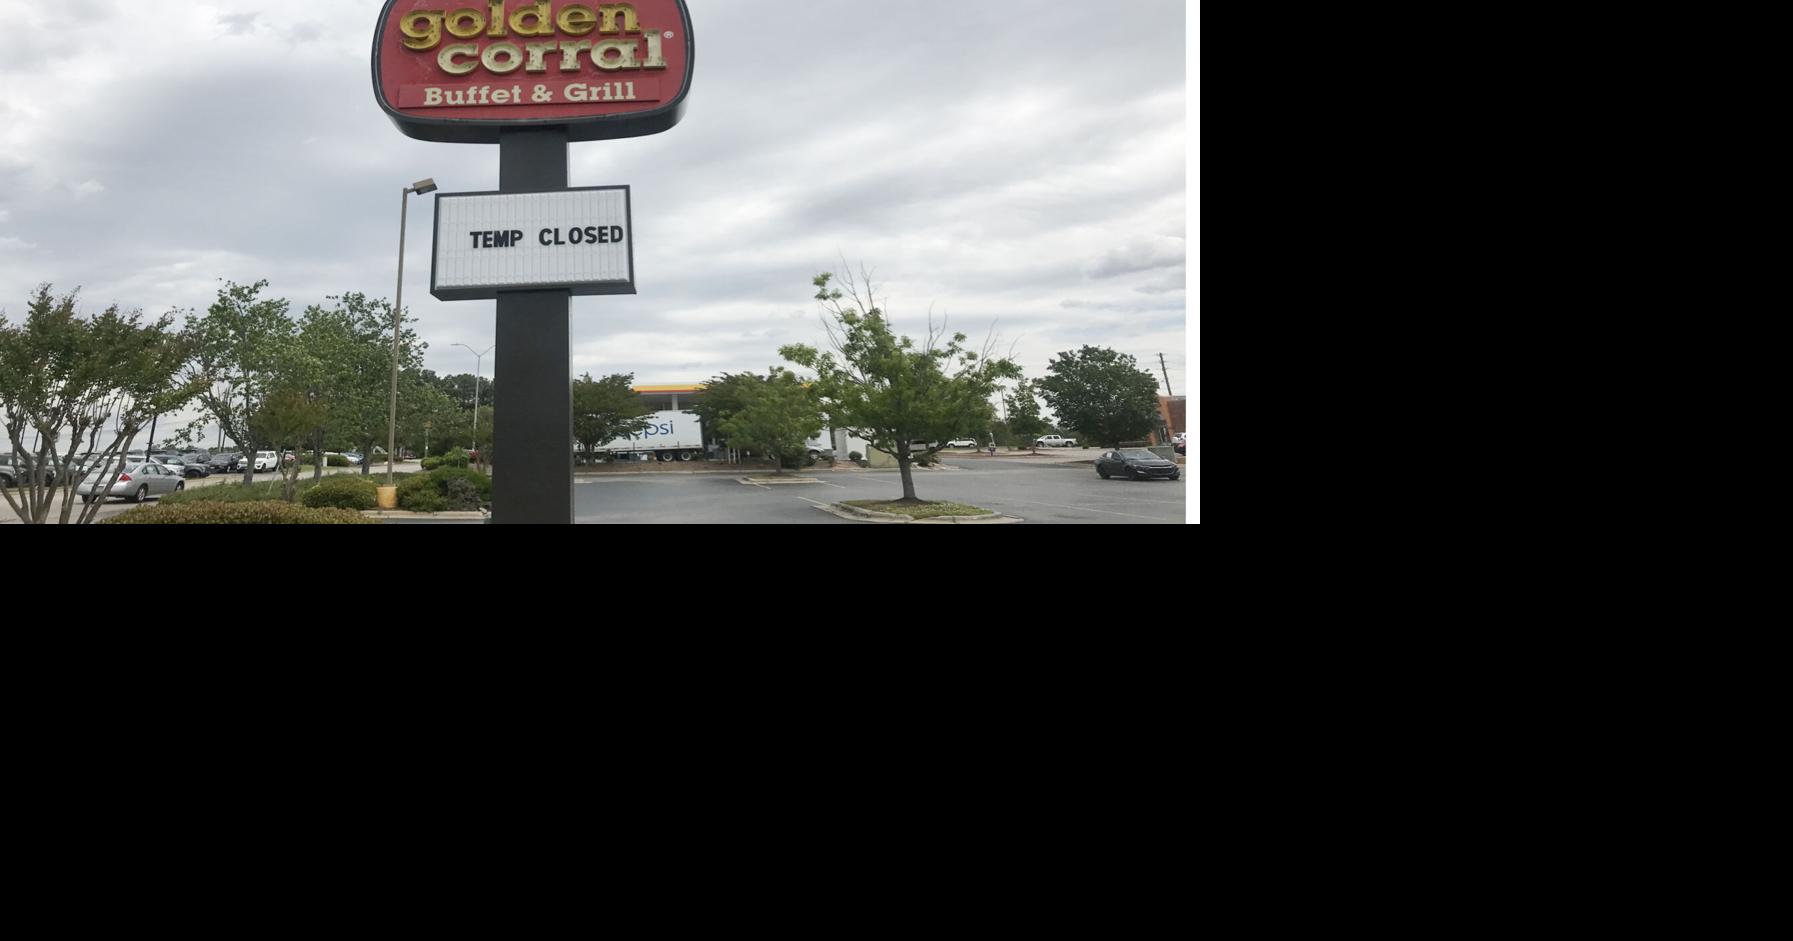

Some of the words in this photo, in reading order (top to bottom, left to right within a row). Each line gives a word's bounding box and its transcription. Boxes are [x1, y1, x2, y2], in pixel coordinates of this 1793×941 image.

[400, 0, 641, 50] golden
[437, 29, 667, 75] corral
[424, 85, 522, 106] Buffet
[531, 85, 553, 103] &
[563, 82, 636, 101] Grill
[469, 230, 523, 248] TEMP
[538, 225, 624, 246] CLOSED
[631, 420, 674, 439] psi
